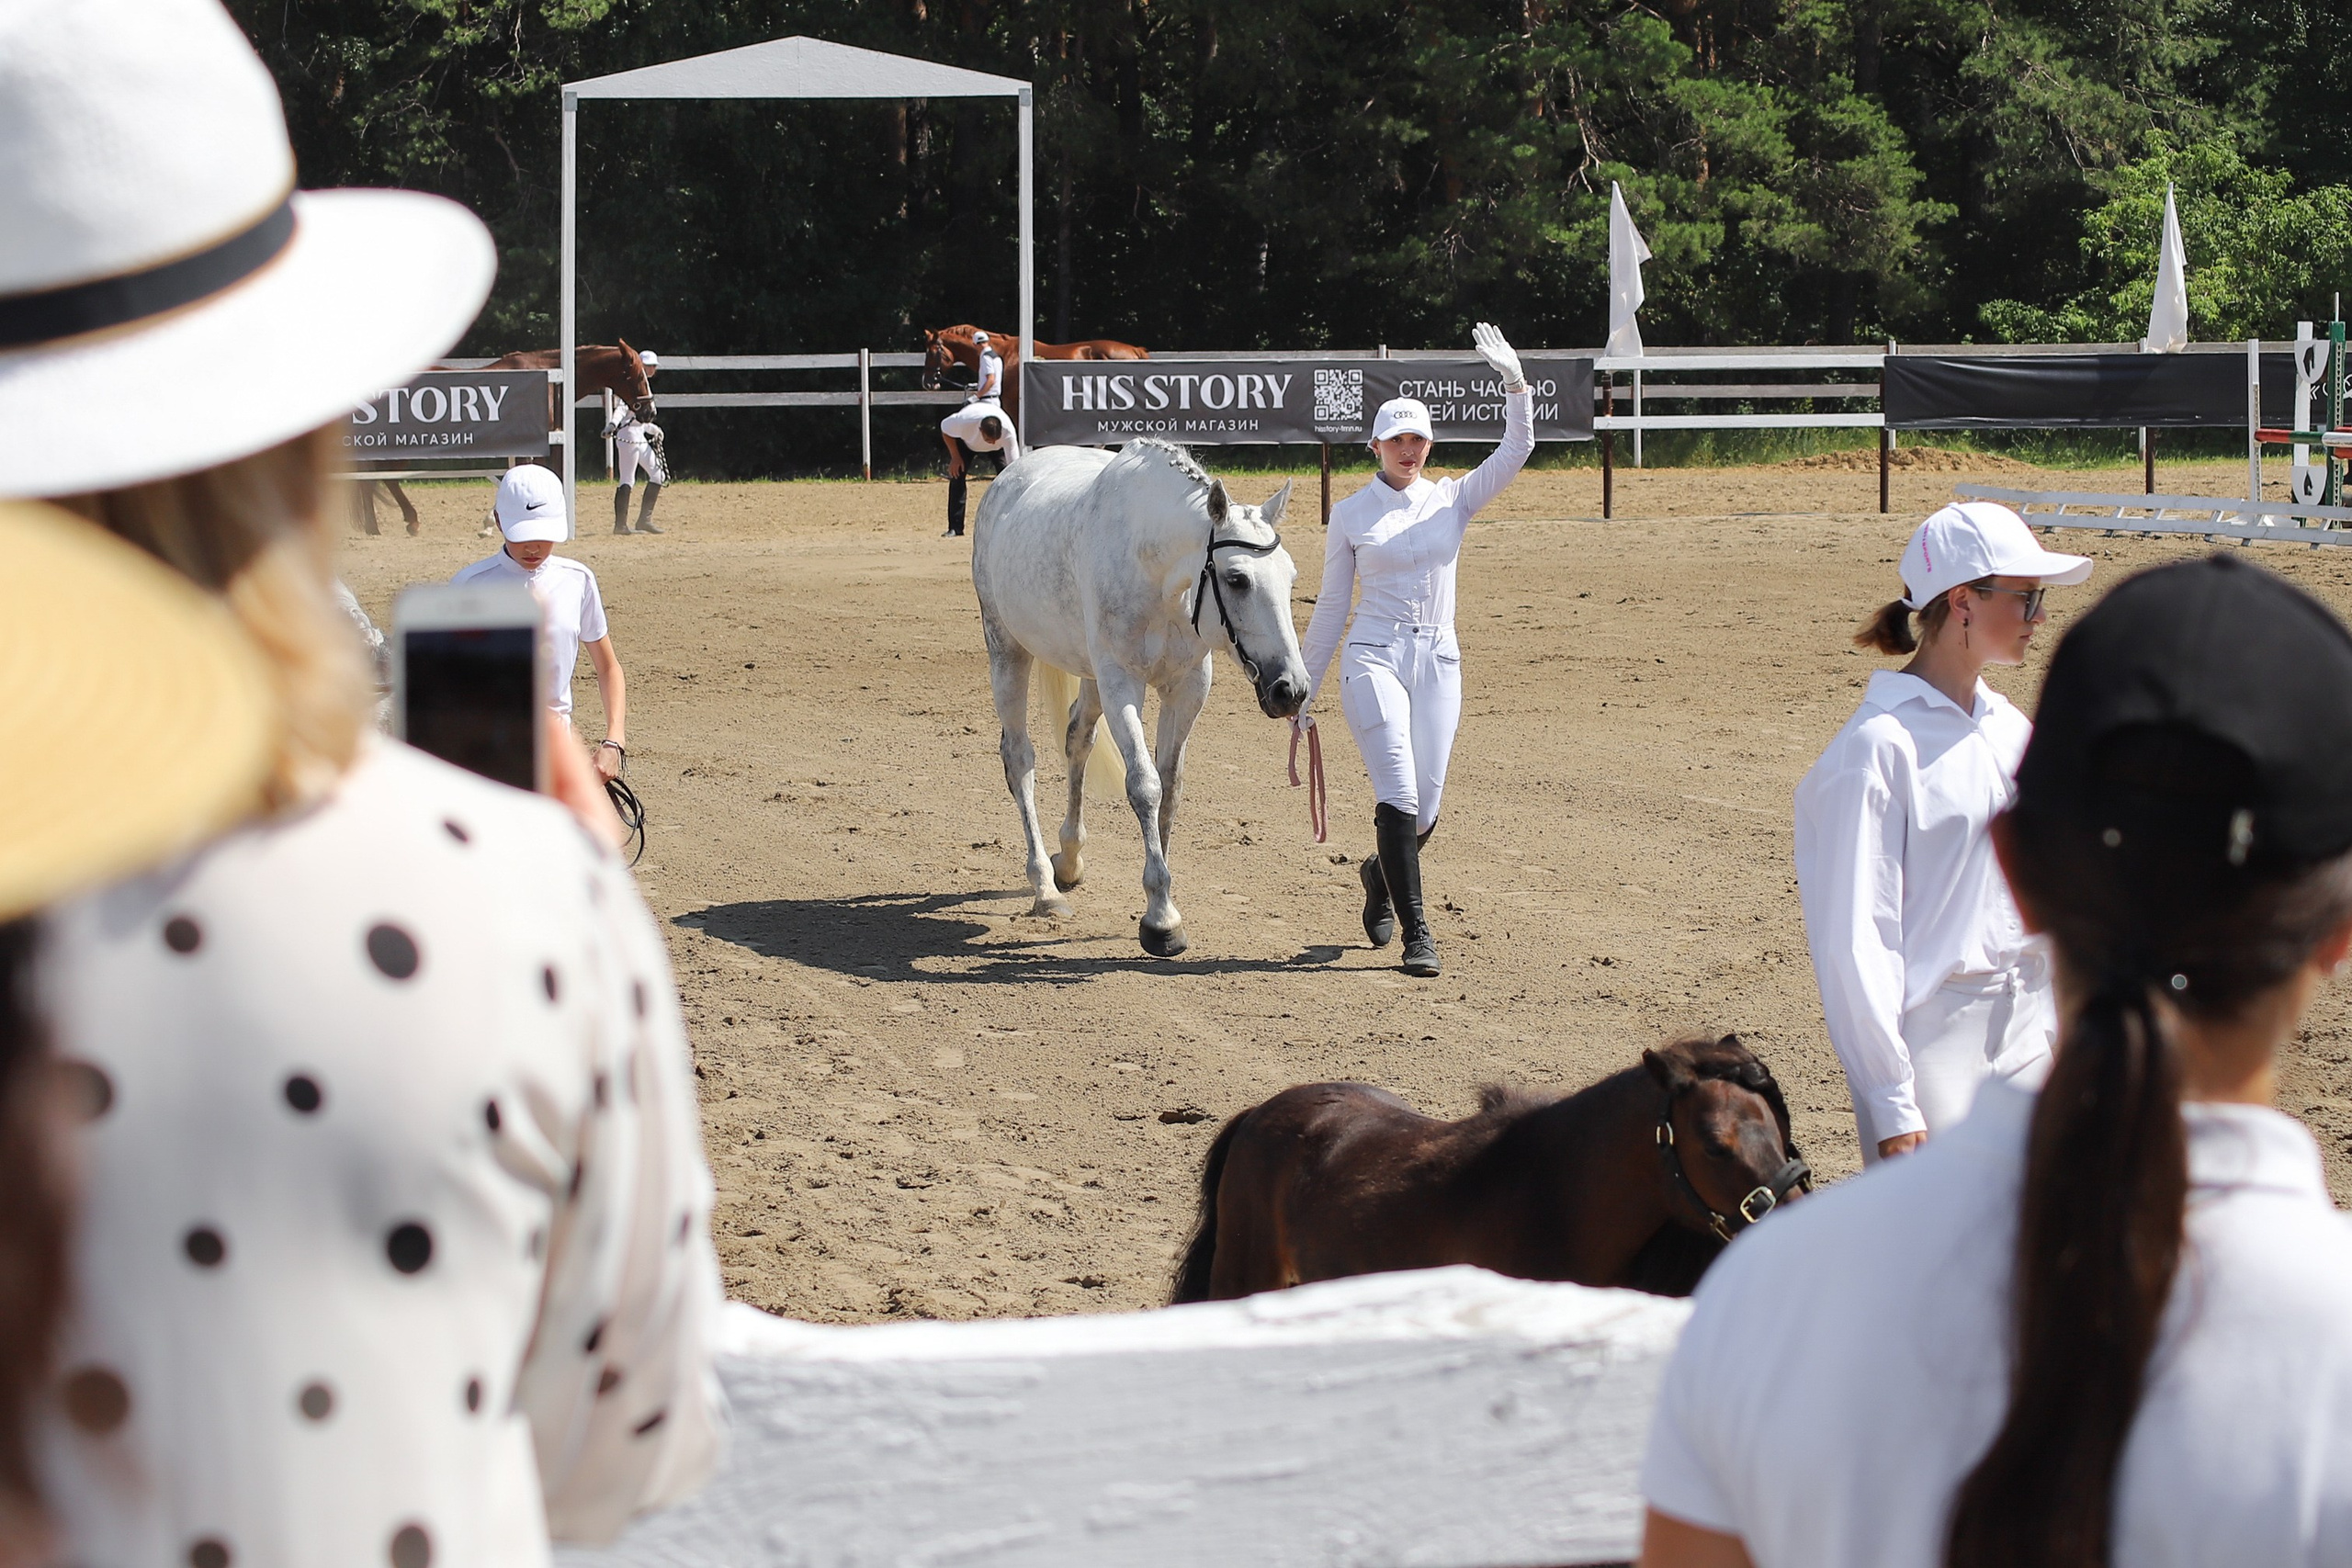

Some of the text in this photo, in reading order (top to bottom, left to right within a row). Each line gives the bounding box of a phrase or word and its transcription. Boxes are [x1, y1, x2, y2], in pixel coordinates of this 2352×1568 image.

[1061, 374, 1294, 411] HIS STORY
[1398, 379, 1465, 398] СТАНЬ
[352, 385, 510, 424] STORY
[1097, 417, 1259, 432] МУЖСКОЙ МАГАЗИН
[342, 432, 474, 446] СКОЙ МАГАЗИН
